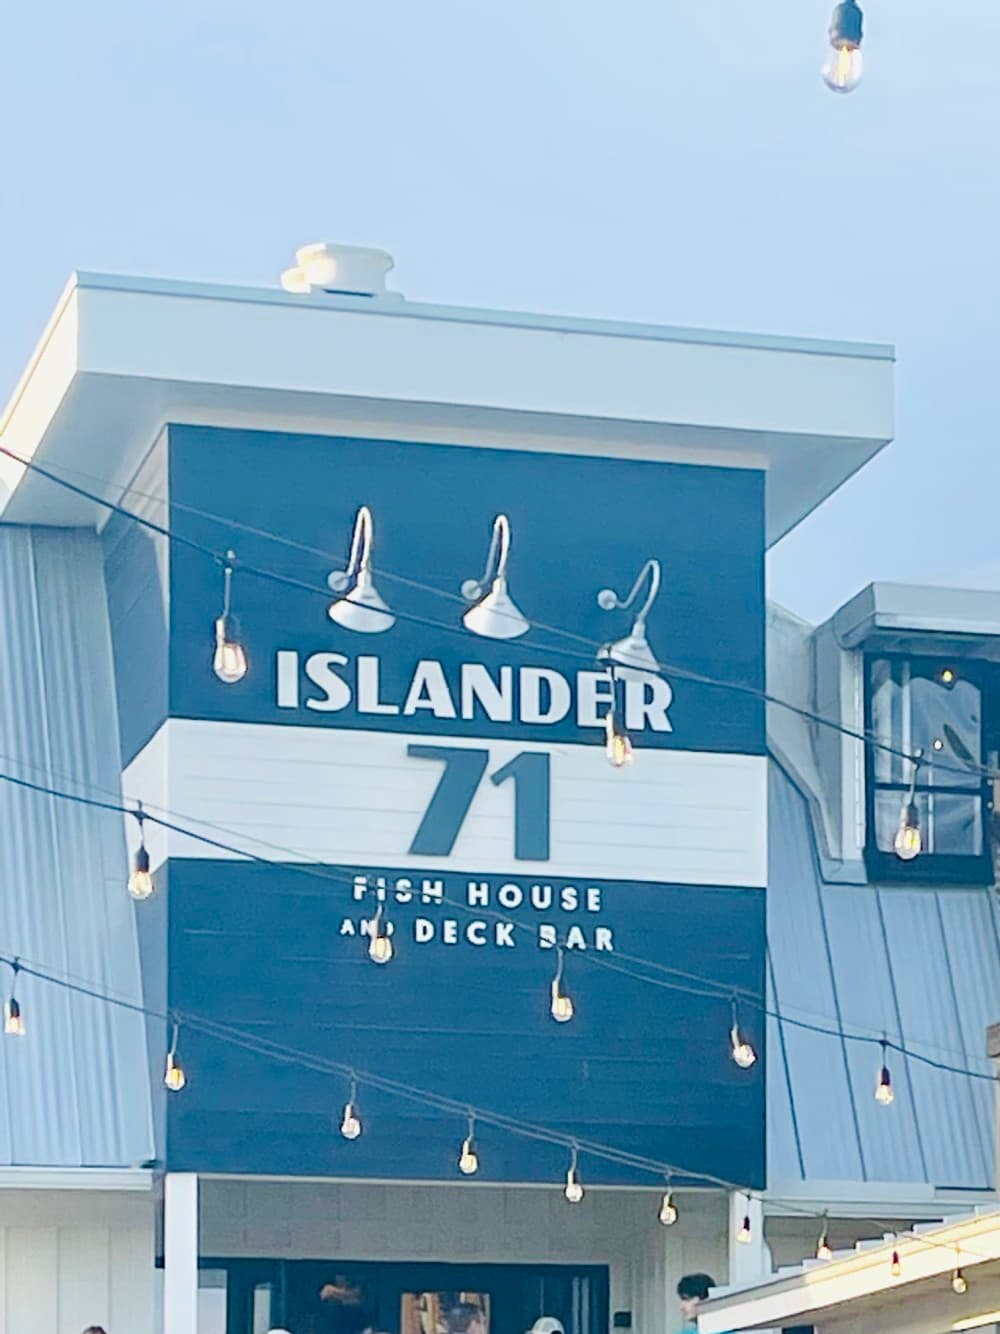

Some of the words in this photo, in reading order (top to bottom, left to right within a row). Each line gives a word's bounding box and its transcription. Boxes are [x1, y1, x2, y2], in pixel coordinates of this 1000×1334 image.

[276, 650, 673, 732] ISLANDER
[407, 744, 550, 861] 71
[353, 876, 443, 905] FISH
[467, 881, 601, 912] HOUSE
[415, 918, 515, 947] DECK
[539, 924, 614, 951] BAR
